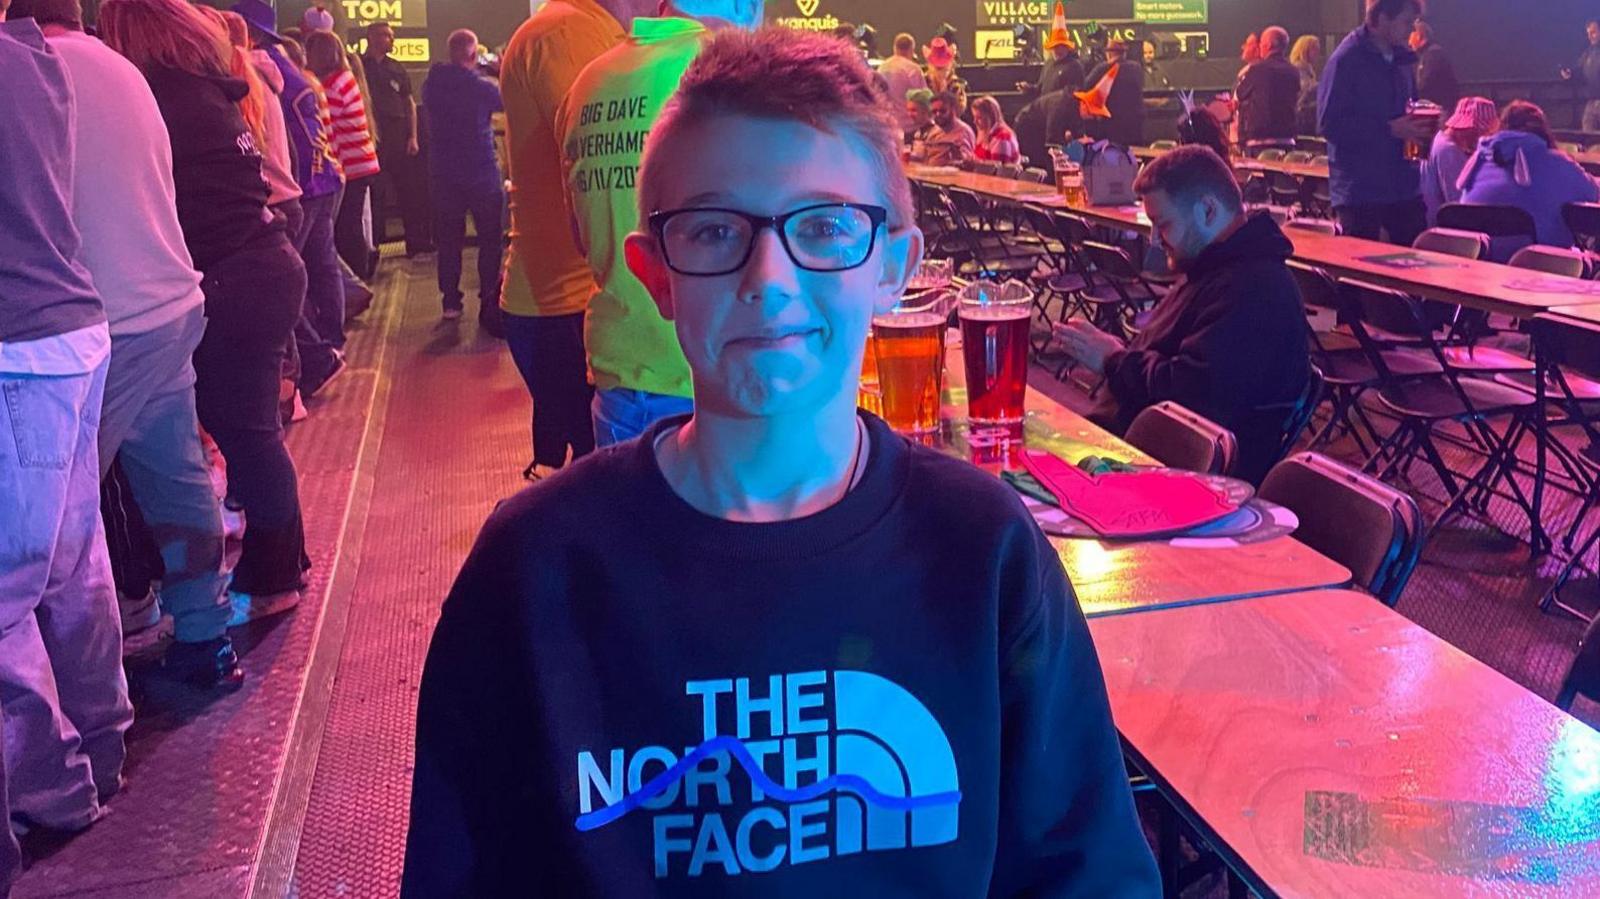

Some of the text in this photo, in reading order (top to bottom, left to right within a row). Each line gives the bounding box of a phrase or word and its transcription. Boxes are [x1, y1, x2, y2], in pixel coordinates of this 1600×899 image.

[342, 0, 402, 19] TOM
[984, 2, 1048, 16] VILLAGE
[580, 96, 648, 126] BIG DAVE
[686, 670, 829, 742] THE
[577, 735, 830, 815] NORTH
[652, 799, 830, 879] FACE
